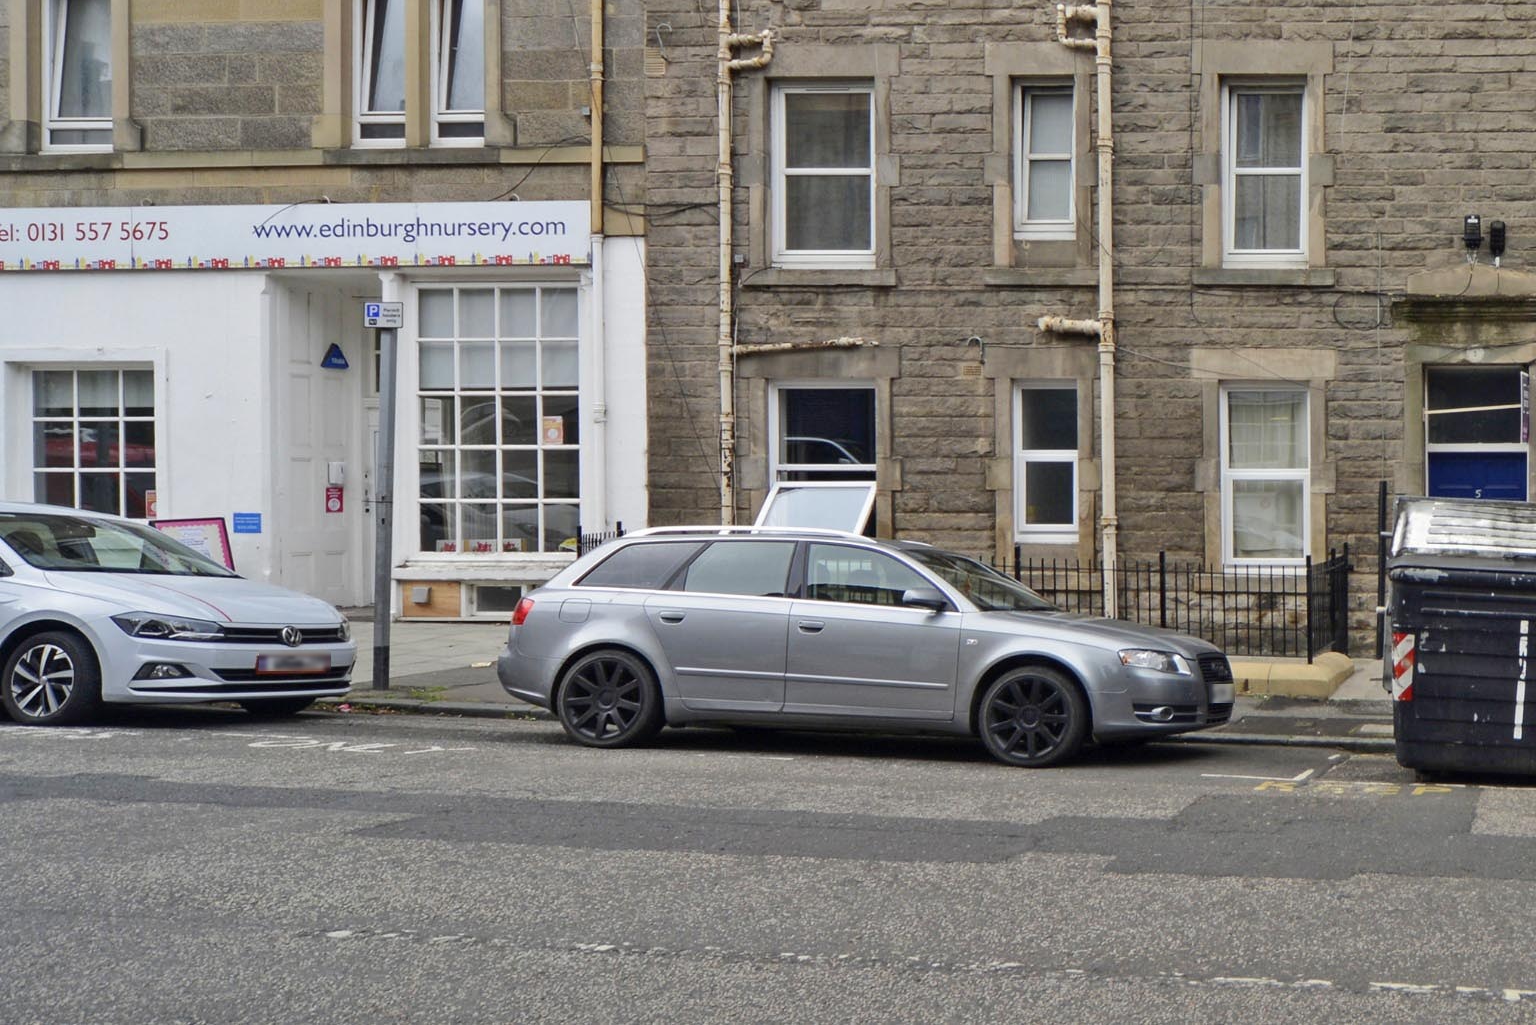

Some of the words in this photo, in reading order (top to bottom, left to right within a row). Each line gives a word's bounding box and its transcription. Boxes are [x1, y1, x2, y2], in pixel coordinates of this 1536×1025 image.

[0, 223, 20, 242] el:
[27, 223, 64, 242] 0131
[75, 222, 112, 241] 557
[120, 221, 169, 241] 5675
[253, 218, 566, 242] www.edinburghnursery.com
